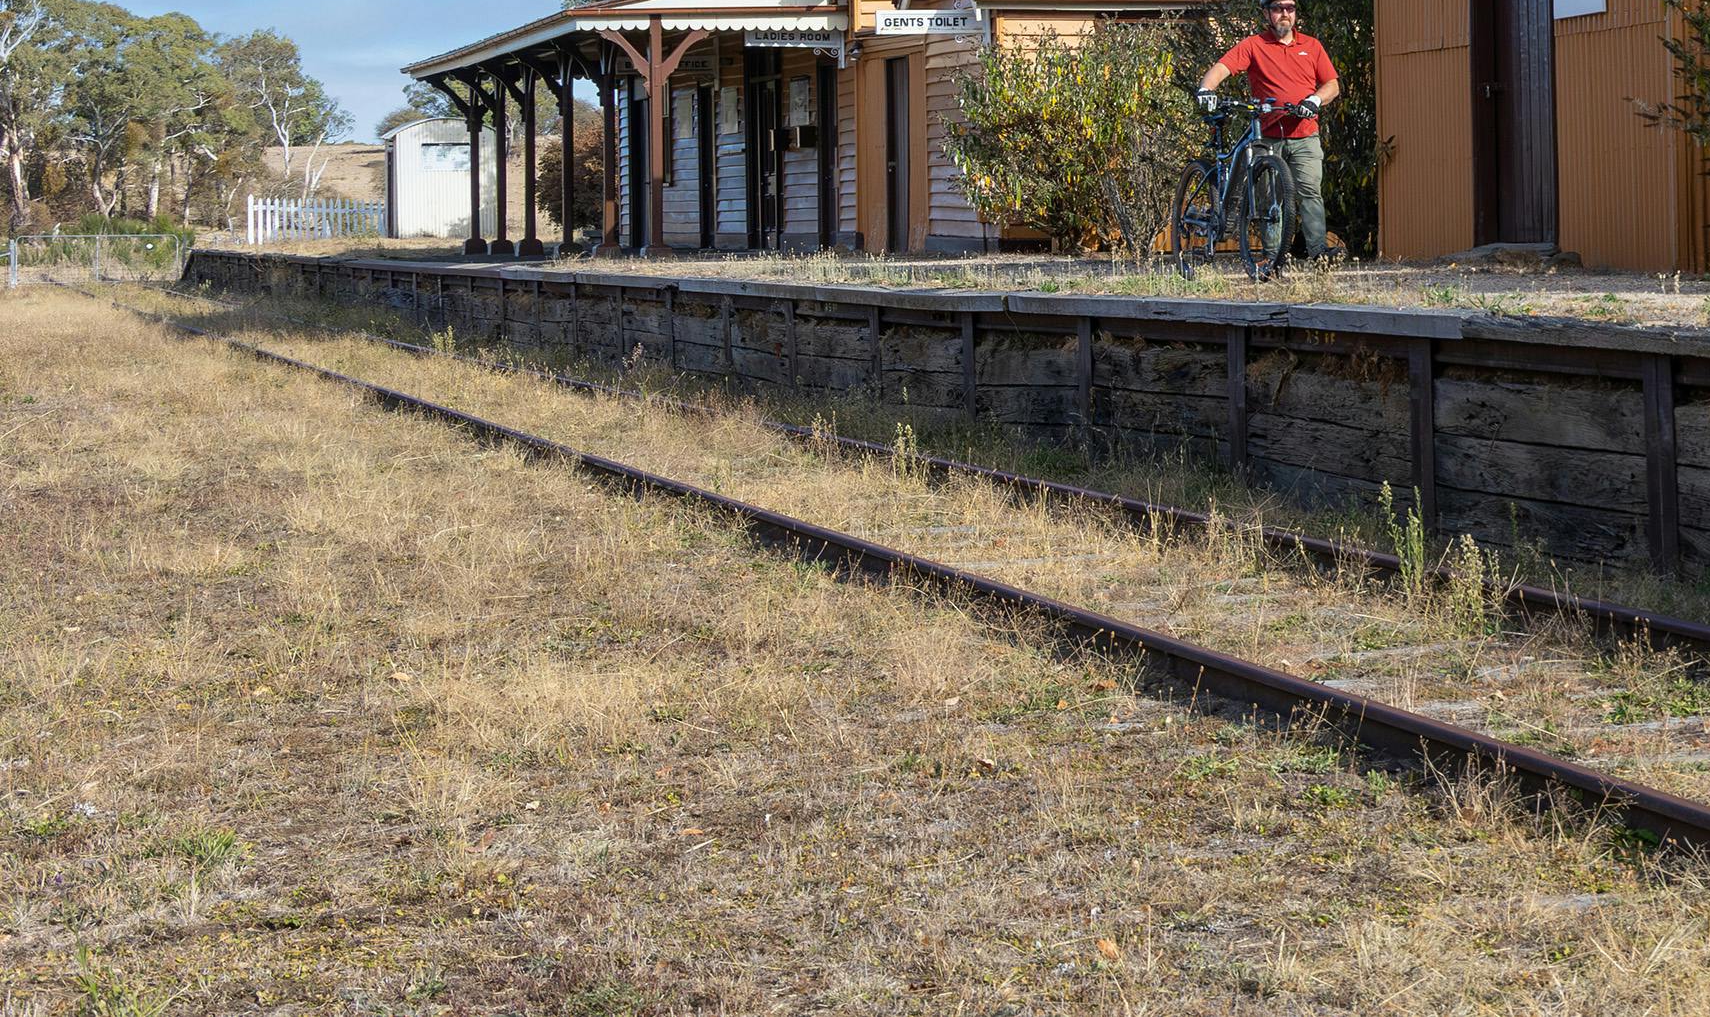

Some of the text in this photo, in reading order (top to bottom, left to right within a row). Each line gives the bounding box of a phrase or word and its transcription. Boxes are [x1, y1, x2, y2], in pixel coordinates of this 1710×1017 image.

[884, 16, 967, 27] GENTS TOILET
[755, 32, 831, 41] LADIES ROOM
